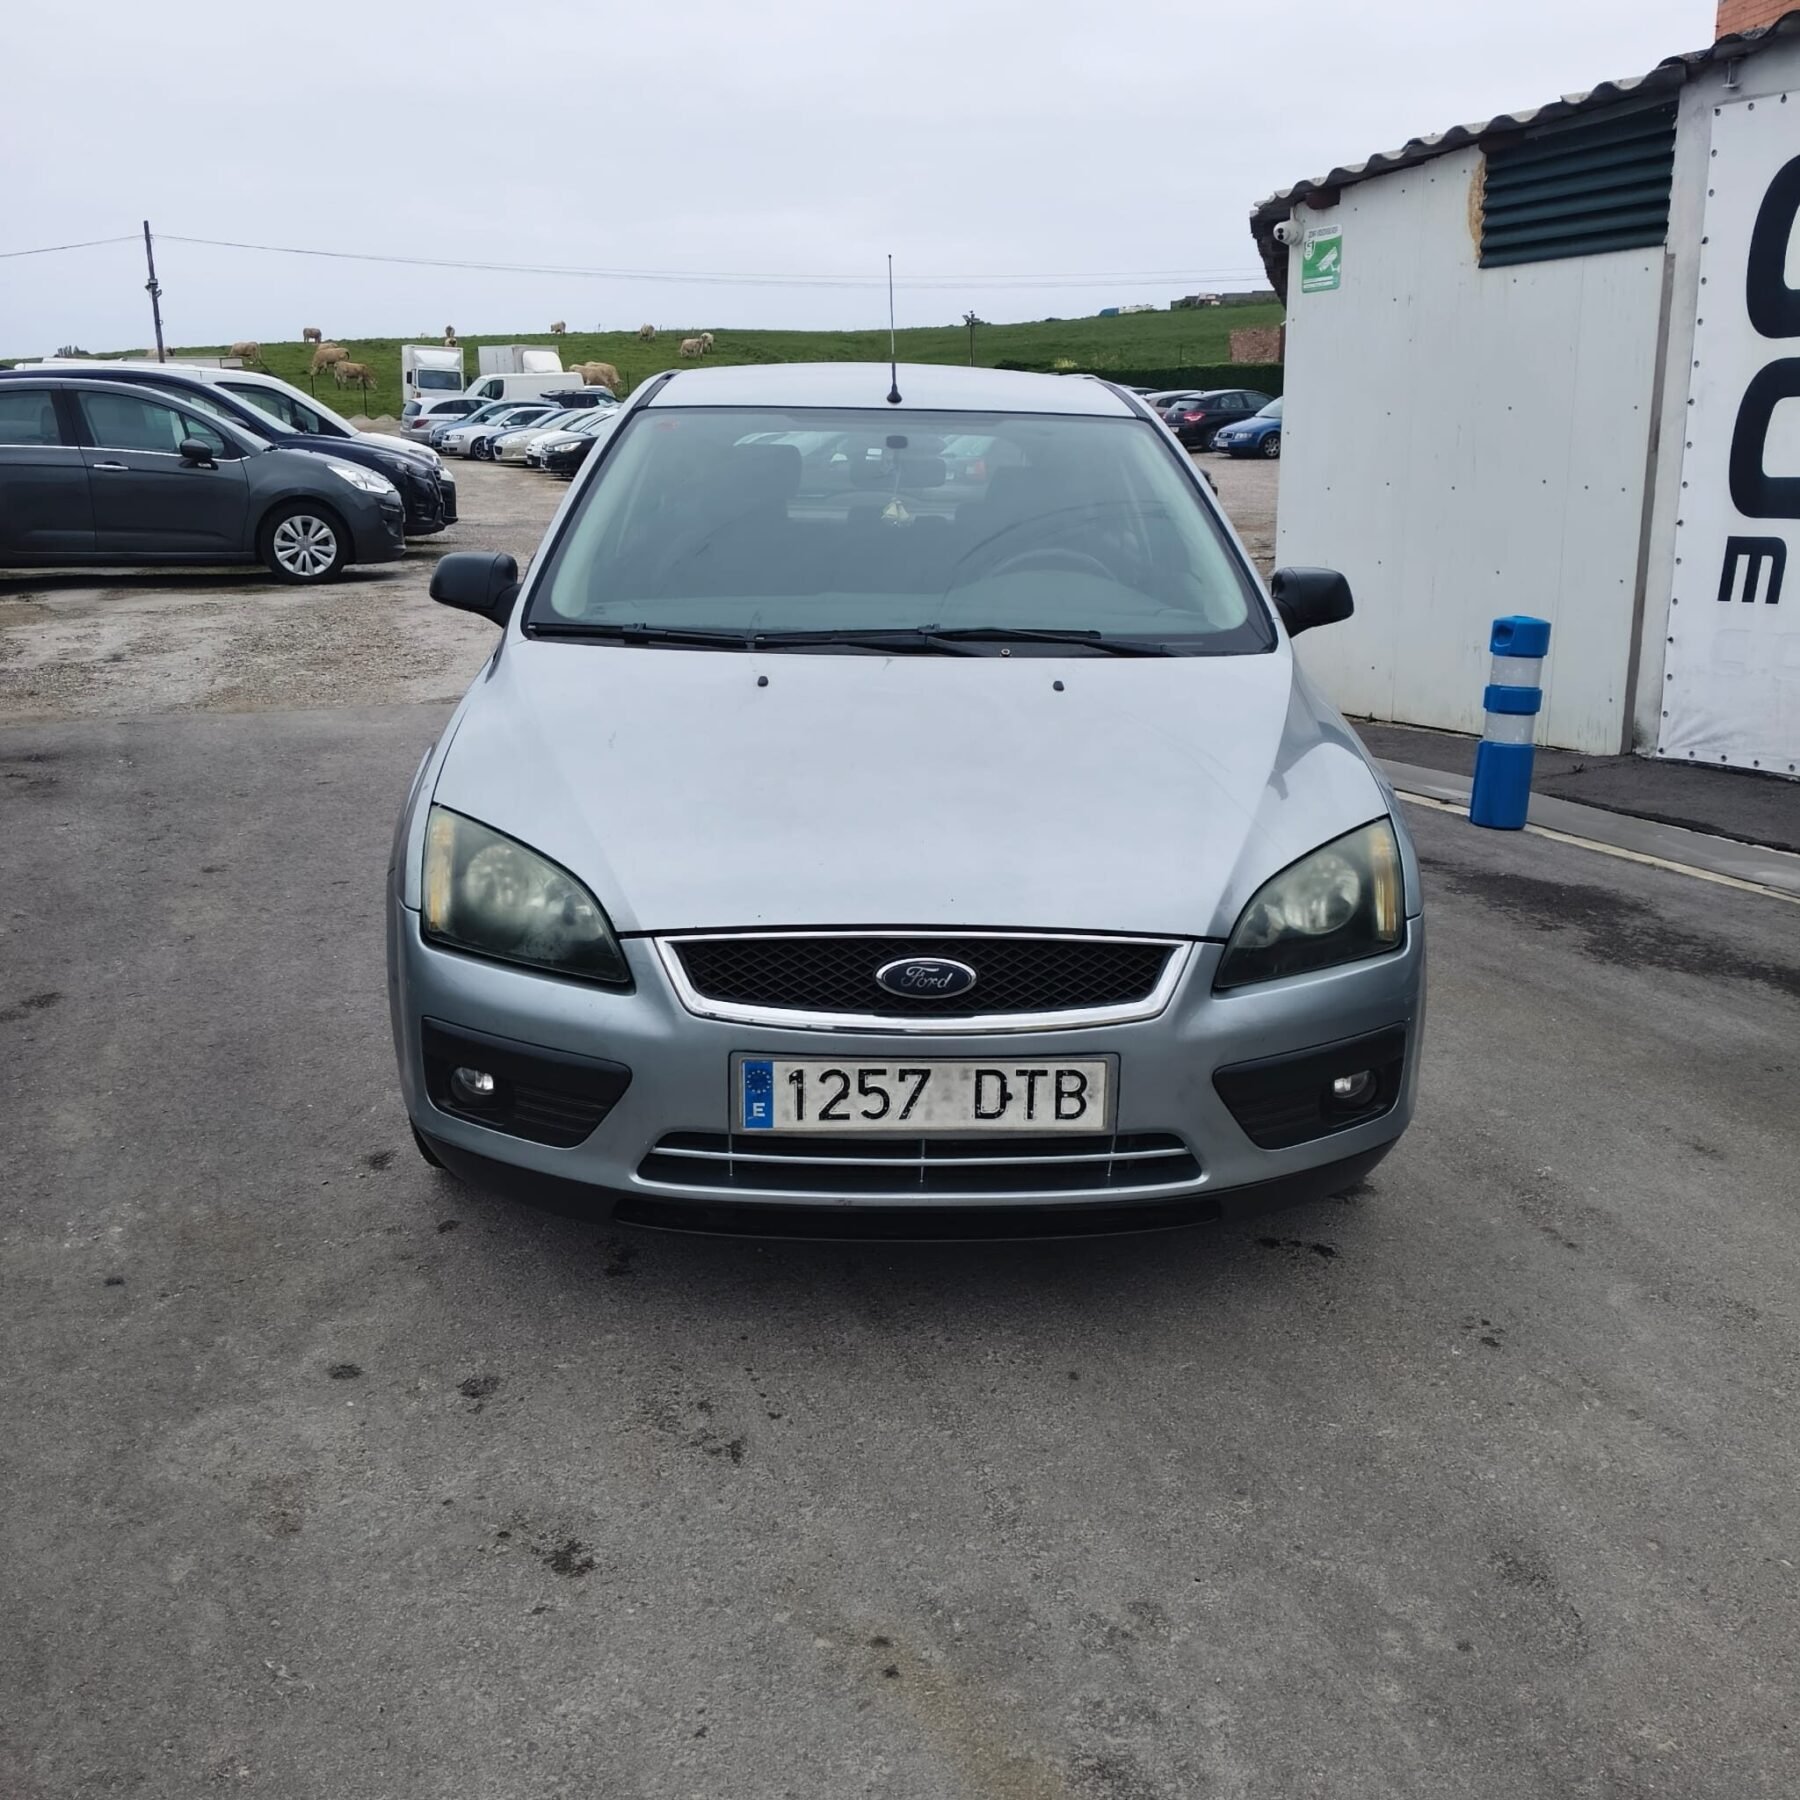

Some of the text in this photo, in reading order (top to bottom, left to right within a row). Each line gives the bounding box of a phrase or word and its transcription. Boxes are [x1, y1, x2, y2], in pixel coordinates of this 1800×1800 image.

[901, 966, 953, 988] Ford
[788, 1068, 1088, 1121] 1257 DTB
[752, 1102, 766, 1117] E
